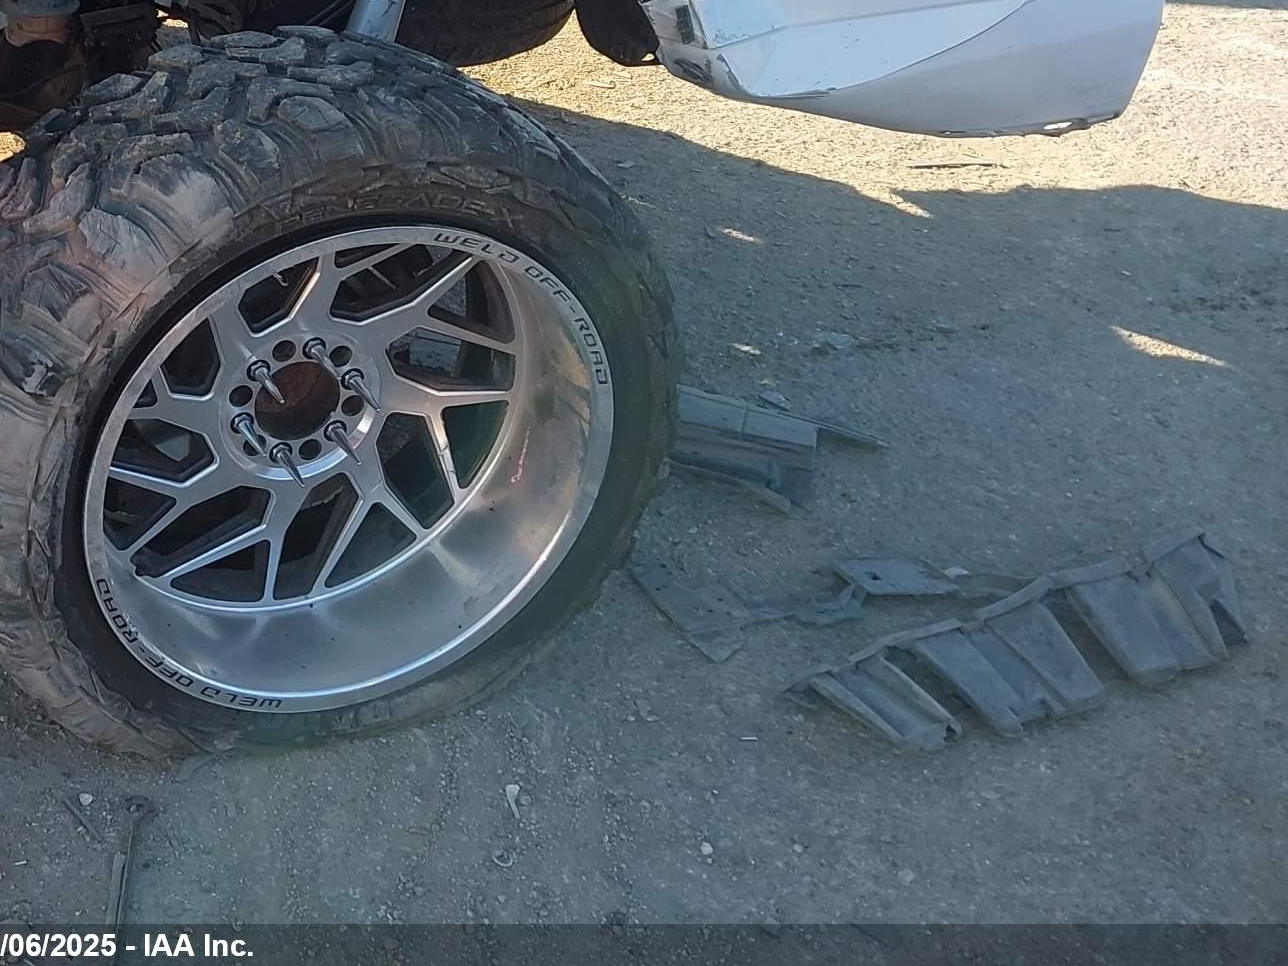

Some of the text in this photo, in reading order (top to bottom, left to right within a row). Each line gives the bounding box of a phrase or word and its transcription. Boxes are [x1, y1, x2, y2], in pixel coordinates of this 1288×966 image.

[432, 232, 608, 385] WELD OFF-ROAD
[96, 578, 282, 709] WELD OFF-ROAD
